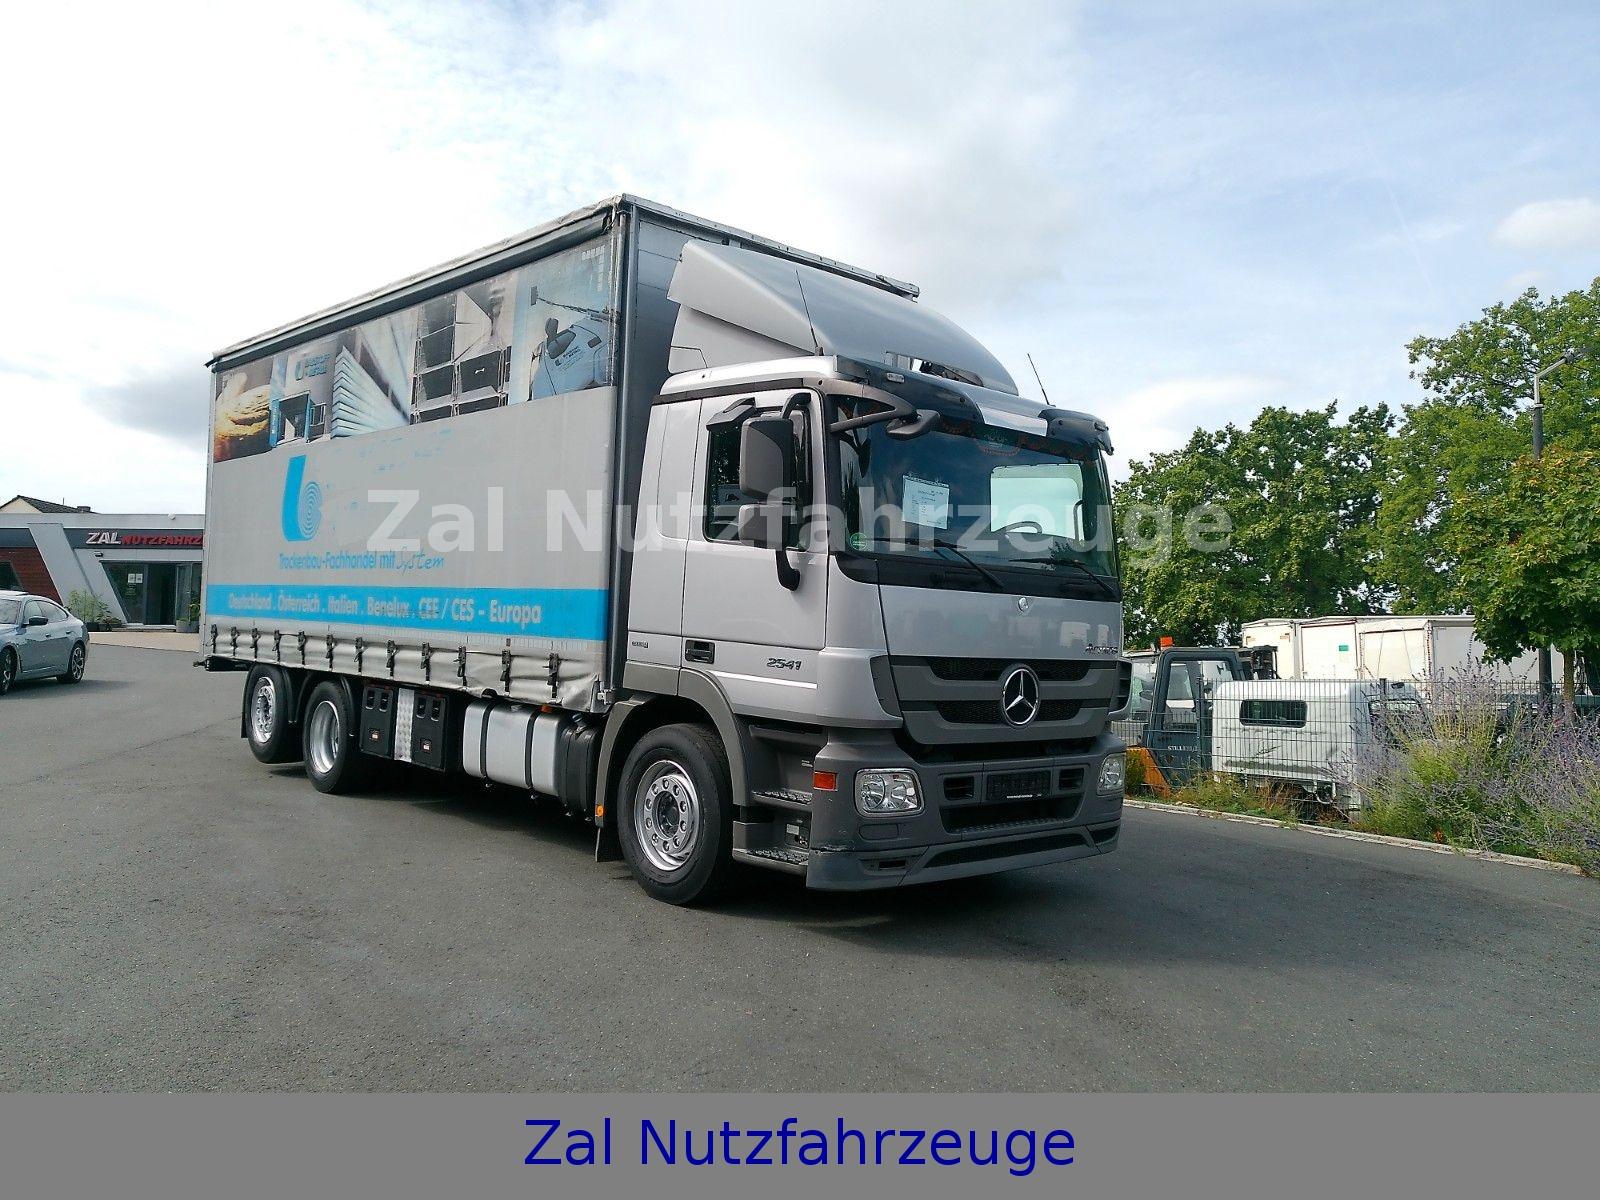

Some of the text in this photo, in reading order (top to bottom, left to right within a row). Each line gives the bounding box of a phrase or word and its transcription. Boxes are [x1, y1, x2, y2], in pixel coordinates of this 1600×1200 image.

[85, 531, 203, 545] ZAL NUTZFAHRZ
[489, 599, 542, 630] Europa
[766, 657, 802, 670] 2541
